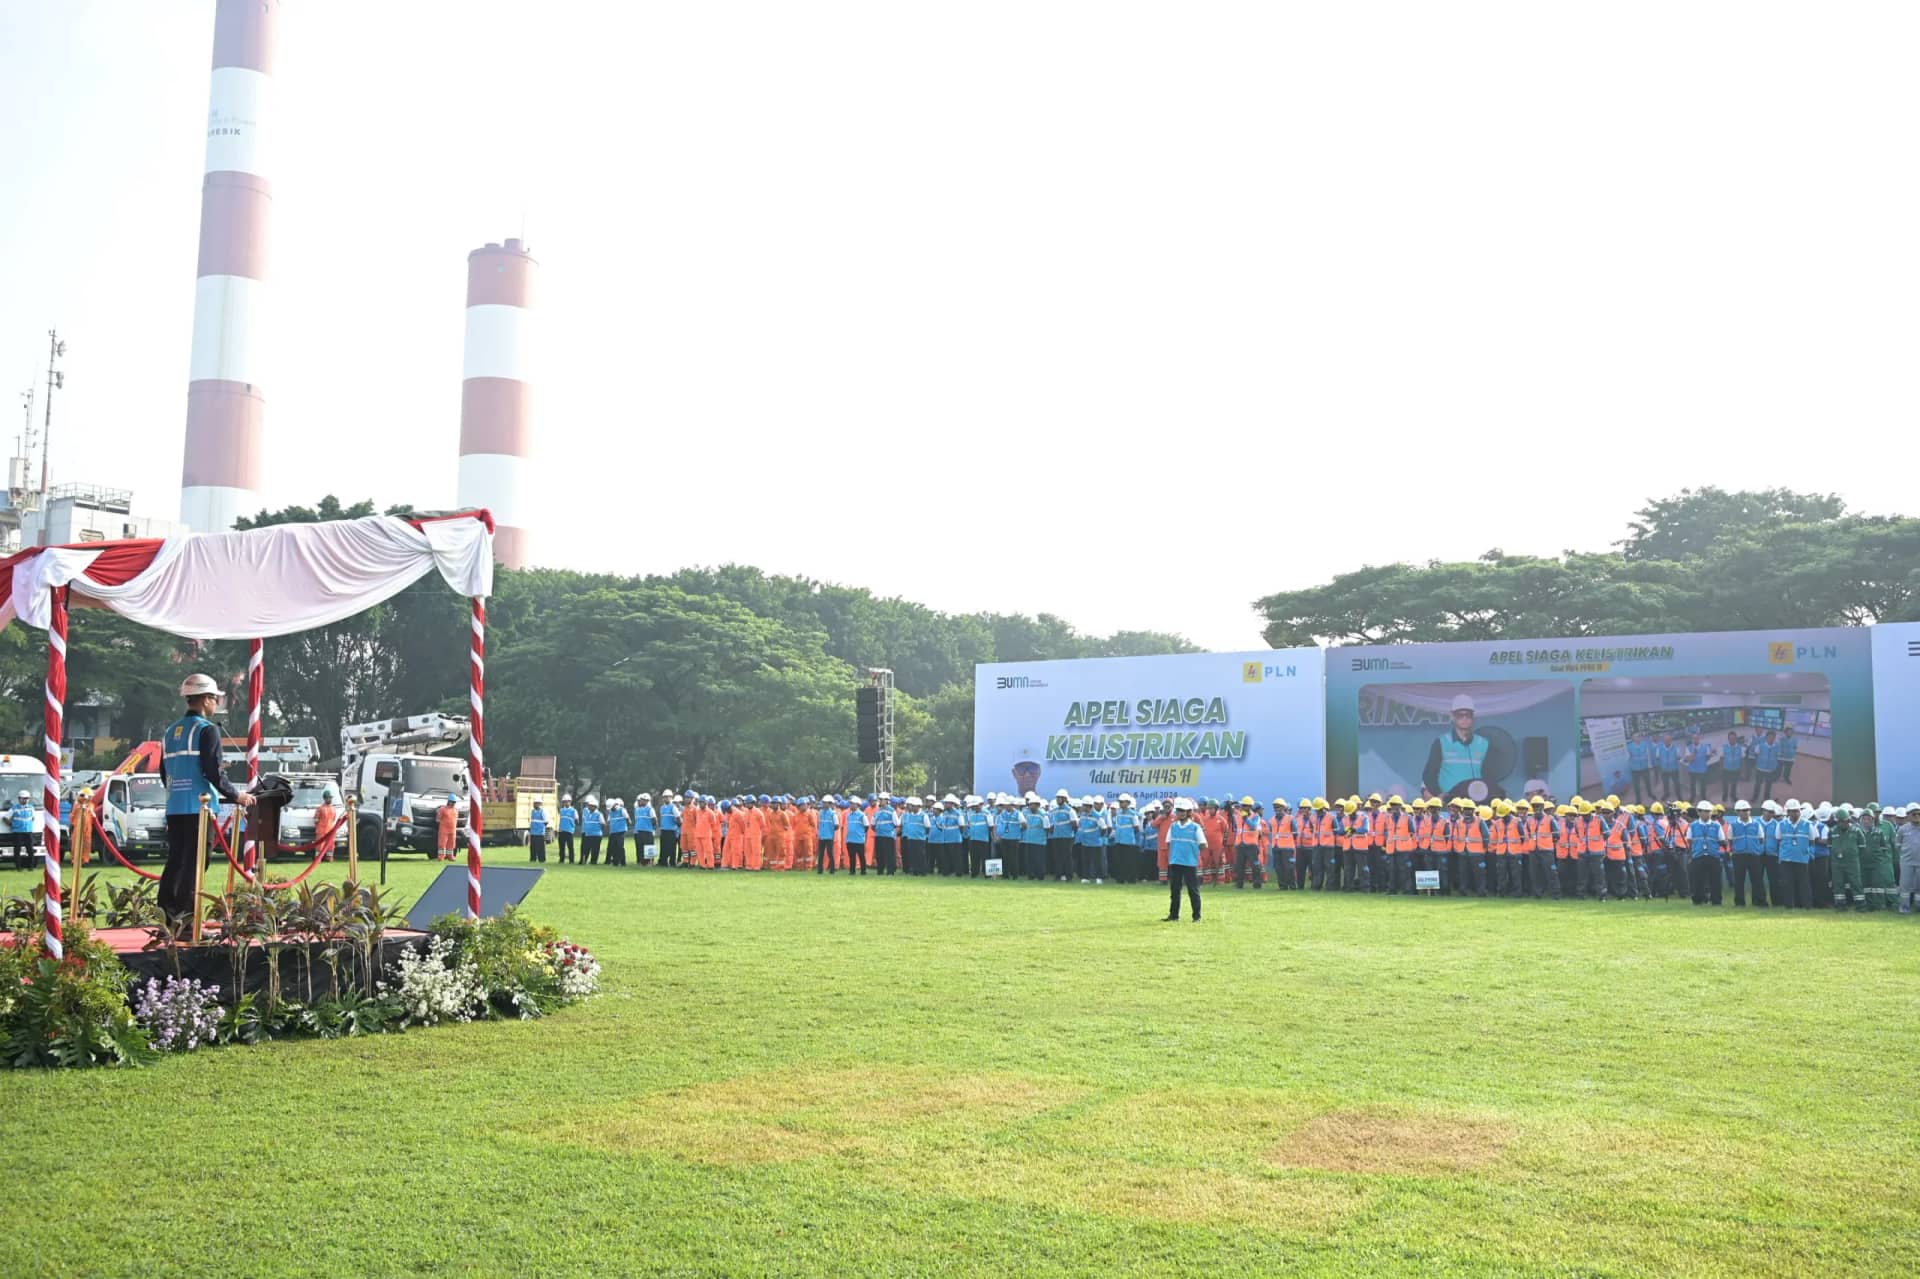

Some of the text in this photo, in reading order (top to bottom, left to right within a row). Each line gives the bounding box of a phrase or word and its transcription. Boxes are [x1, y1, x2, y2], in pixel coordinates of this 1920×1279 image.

[1489, 646, 1674, 664] APEL SIAGA KELISTRIKAN
[1796, 645, 1836, 659] PLN
[1264, 665, 1296, 678] PLN
[1352, 658, 1389, 671] BUMN
[997, 676, 1029, 689] BUMN
[1064, 696, 1226, 726] APEL SIAGA
[1045, 730, 1246, 760] KELISTRIKAN
[1089, 767, 1192, 784] Idul Fitri 1445 H
[1140, 791, 1158, 800] April
